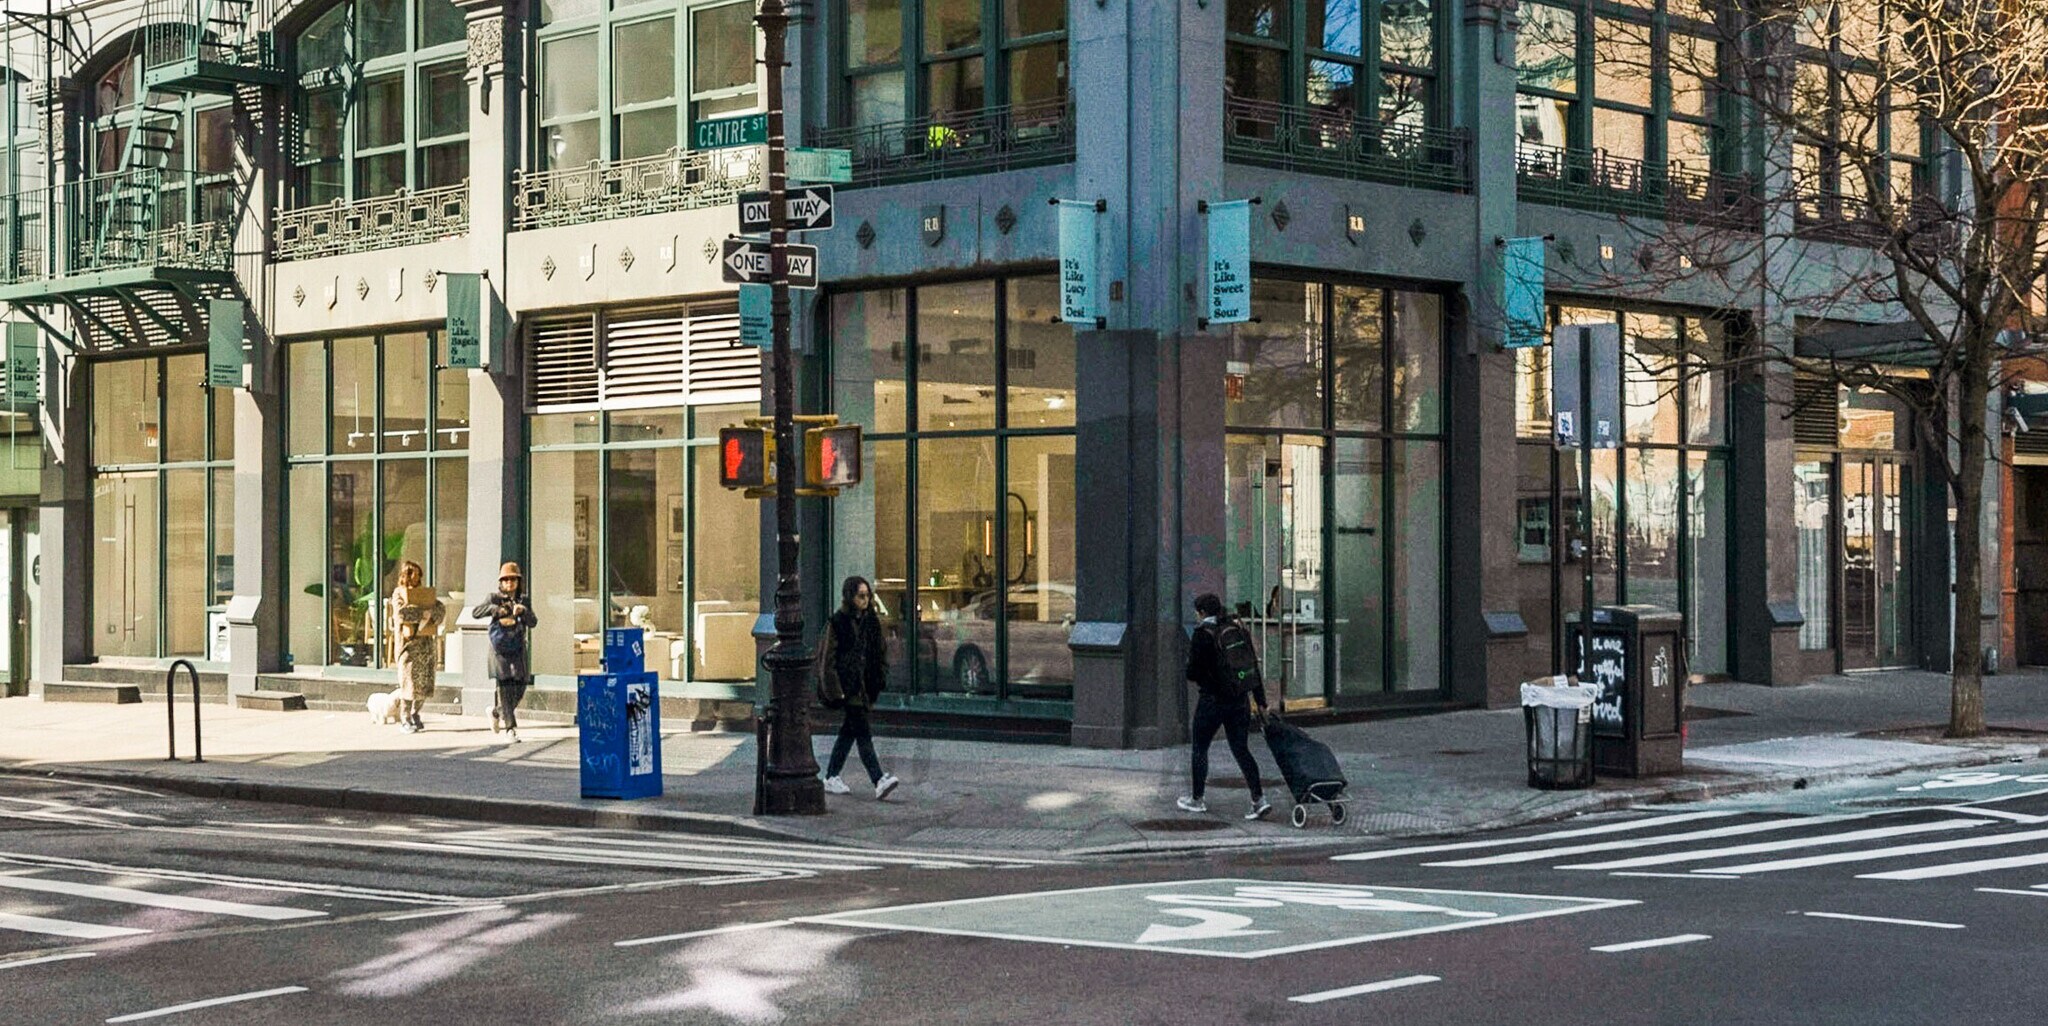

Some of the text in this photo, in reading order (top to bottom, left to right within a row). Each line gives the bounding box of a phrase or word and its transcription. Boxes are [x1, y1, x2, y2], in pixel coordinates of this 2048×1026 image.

[699, 118, 764, 147] CENTRE ST
[792, 199, 821, 217] WAY
[733, 253, 766, 272] ONE
[1065, 258, 1079, 269] It's
[1214, 260, 1230, 271] It's
[1065, 270, 1084, 281] Like
[1214, 271, 1235, 283] Like
[1066, 283, 1086, 296] Lucy
[1213, 284, 1244, 295] Sweet
[1213, 296, 1222, 307] &
[1066, 306, 1085, 318] Desi
[1213, 308, 1239, 318] Sour
[451, 327, 469, 336] Like
[451, 337, 479, 348] Bagels
[451, 356, 467, 365] Lox
